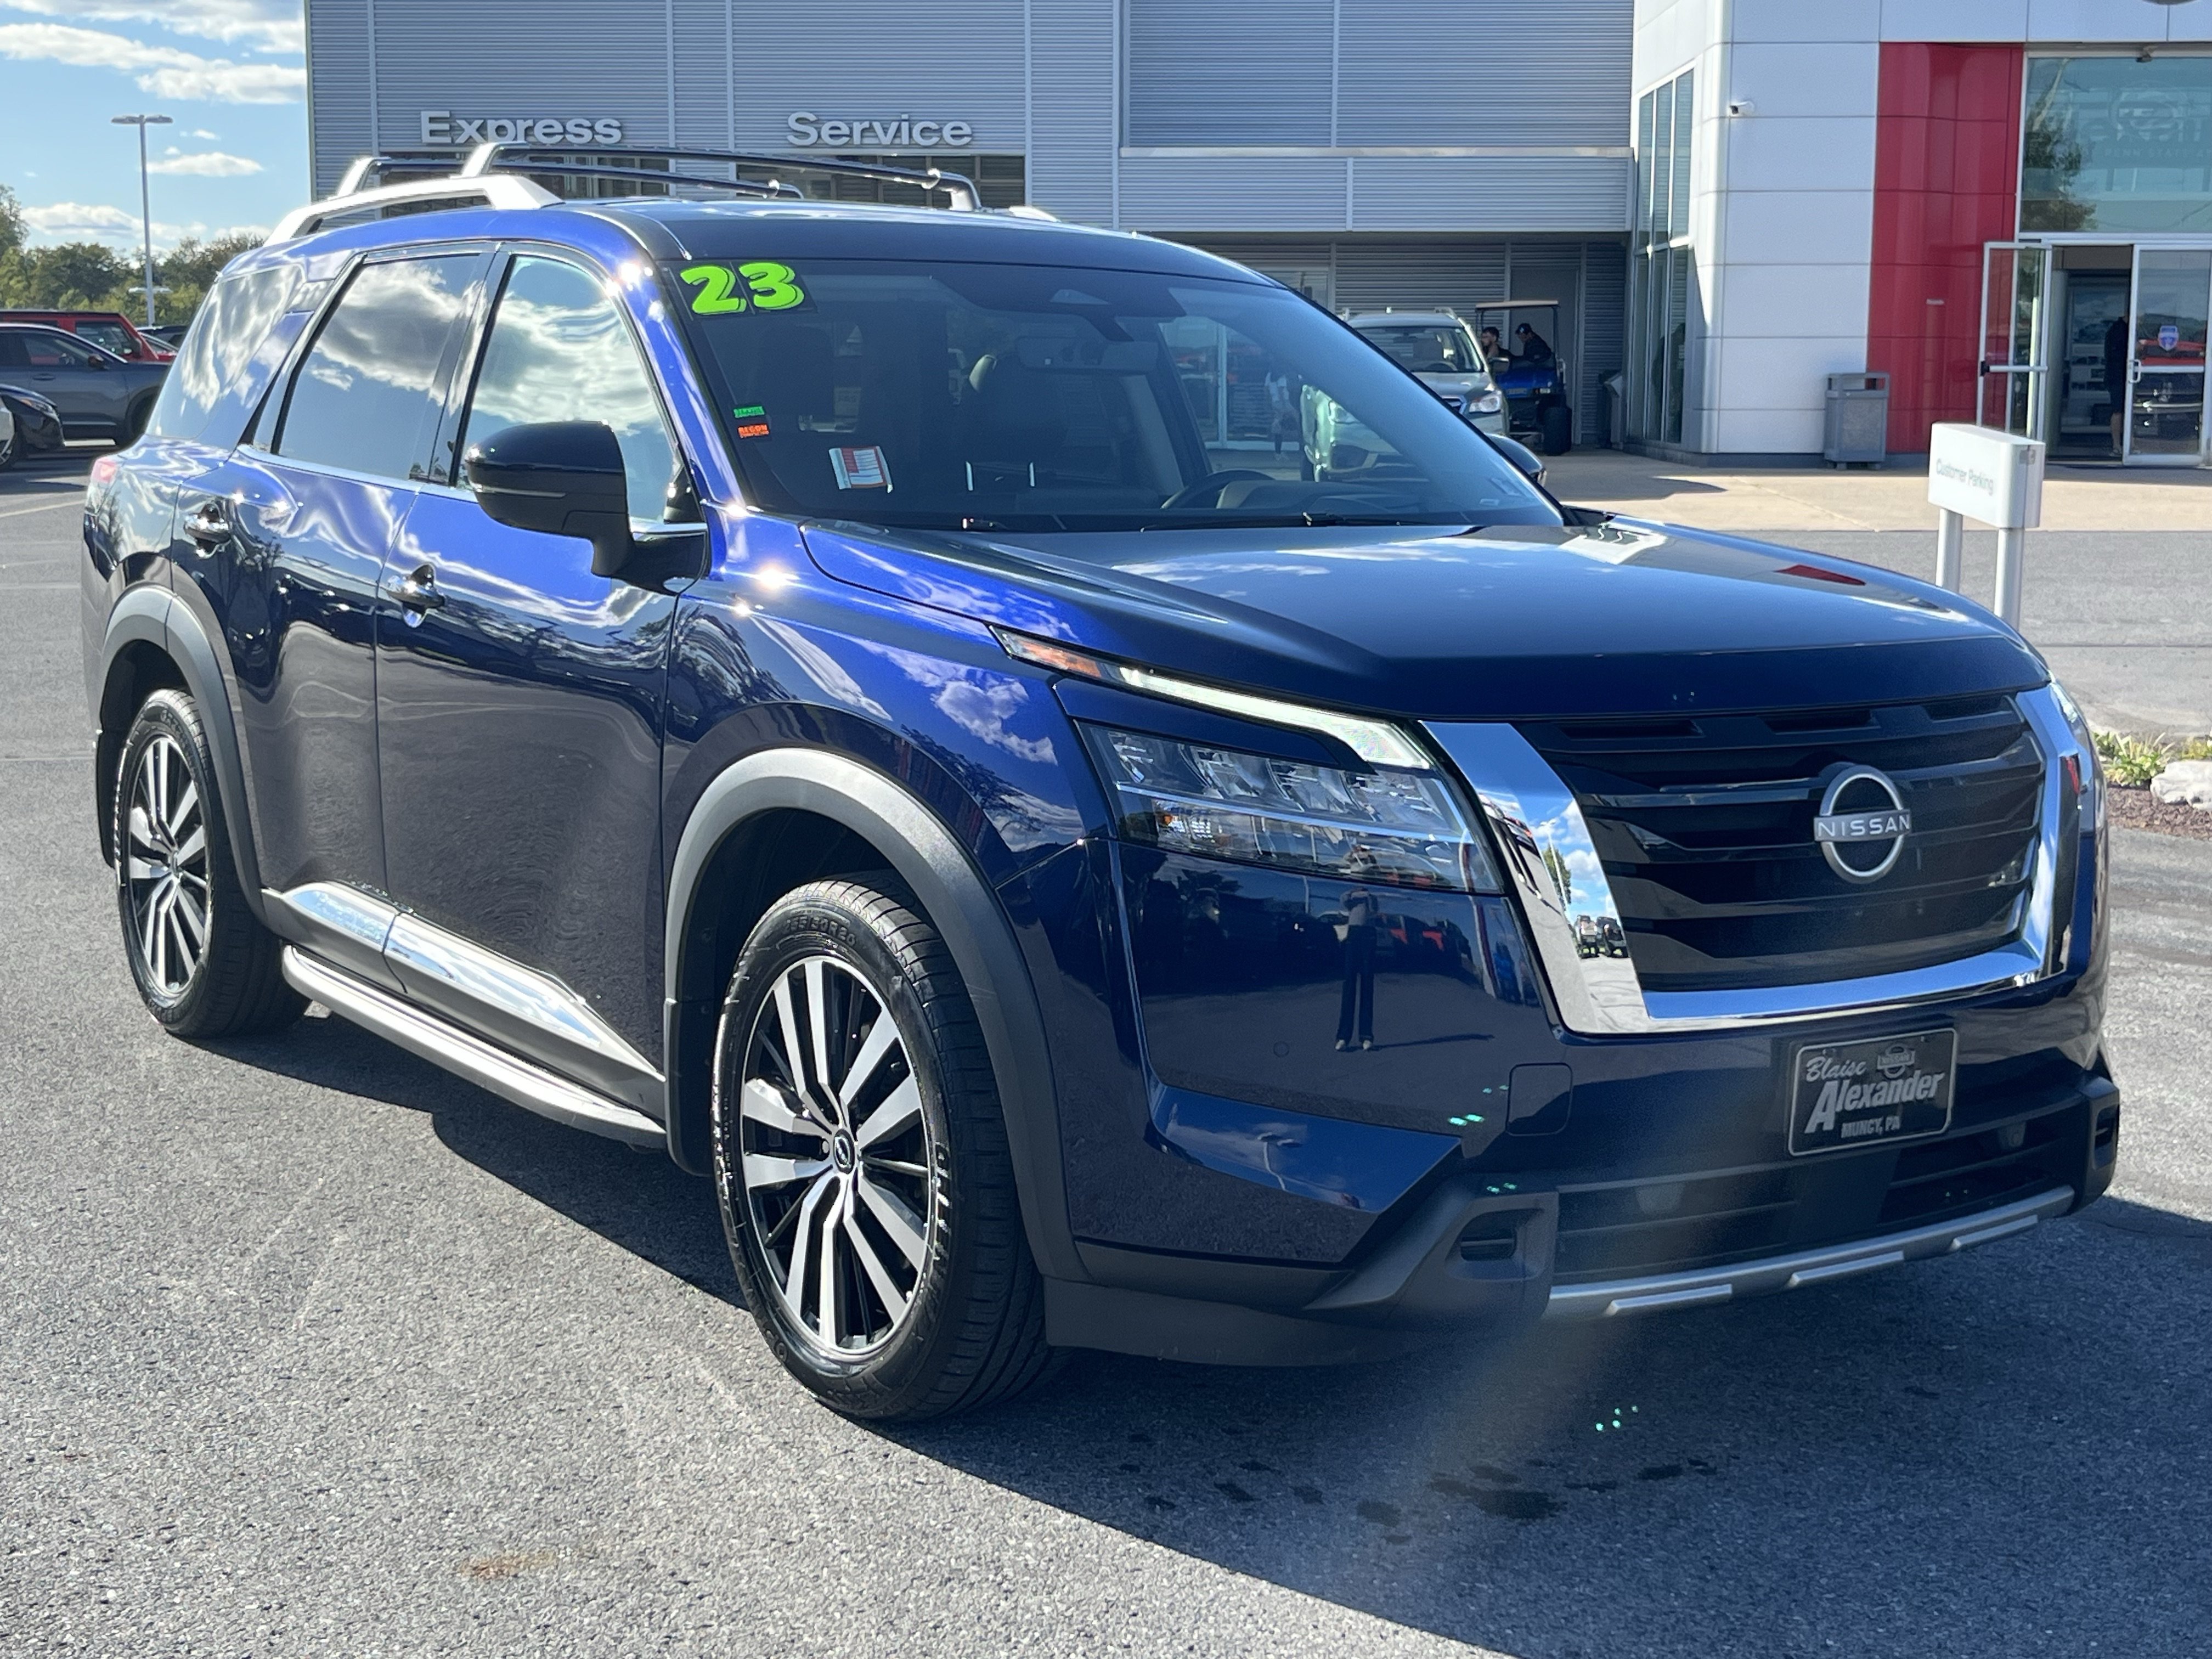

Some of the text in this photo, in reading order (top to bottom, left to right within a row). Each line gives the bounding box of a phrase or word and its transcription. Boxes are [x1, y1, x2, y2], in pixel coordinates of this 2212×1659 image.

[420, 110, 623, 145] Express
[786, 111, 973, 147] Service
[680, 262, 805, 315] 23
[1936, 458, 1994, 496] Customer Parking
[1817, 814, 1911, 837] NISSAN
[1806, 1056, 1866, 1082] Blaise
[1804, 1070, 1945, 1134] Alexander
